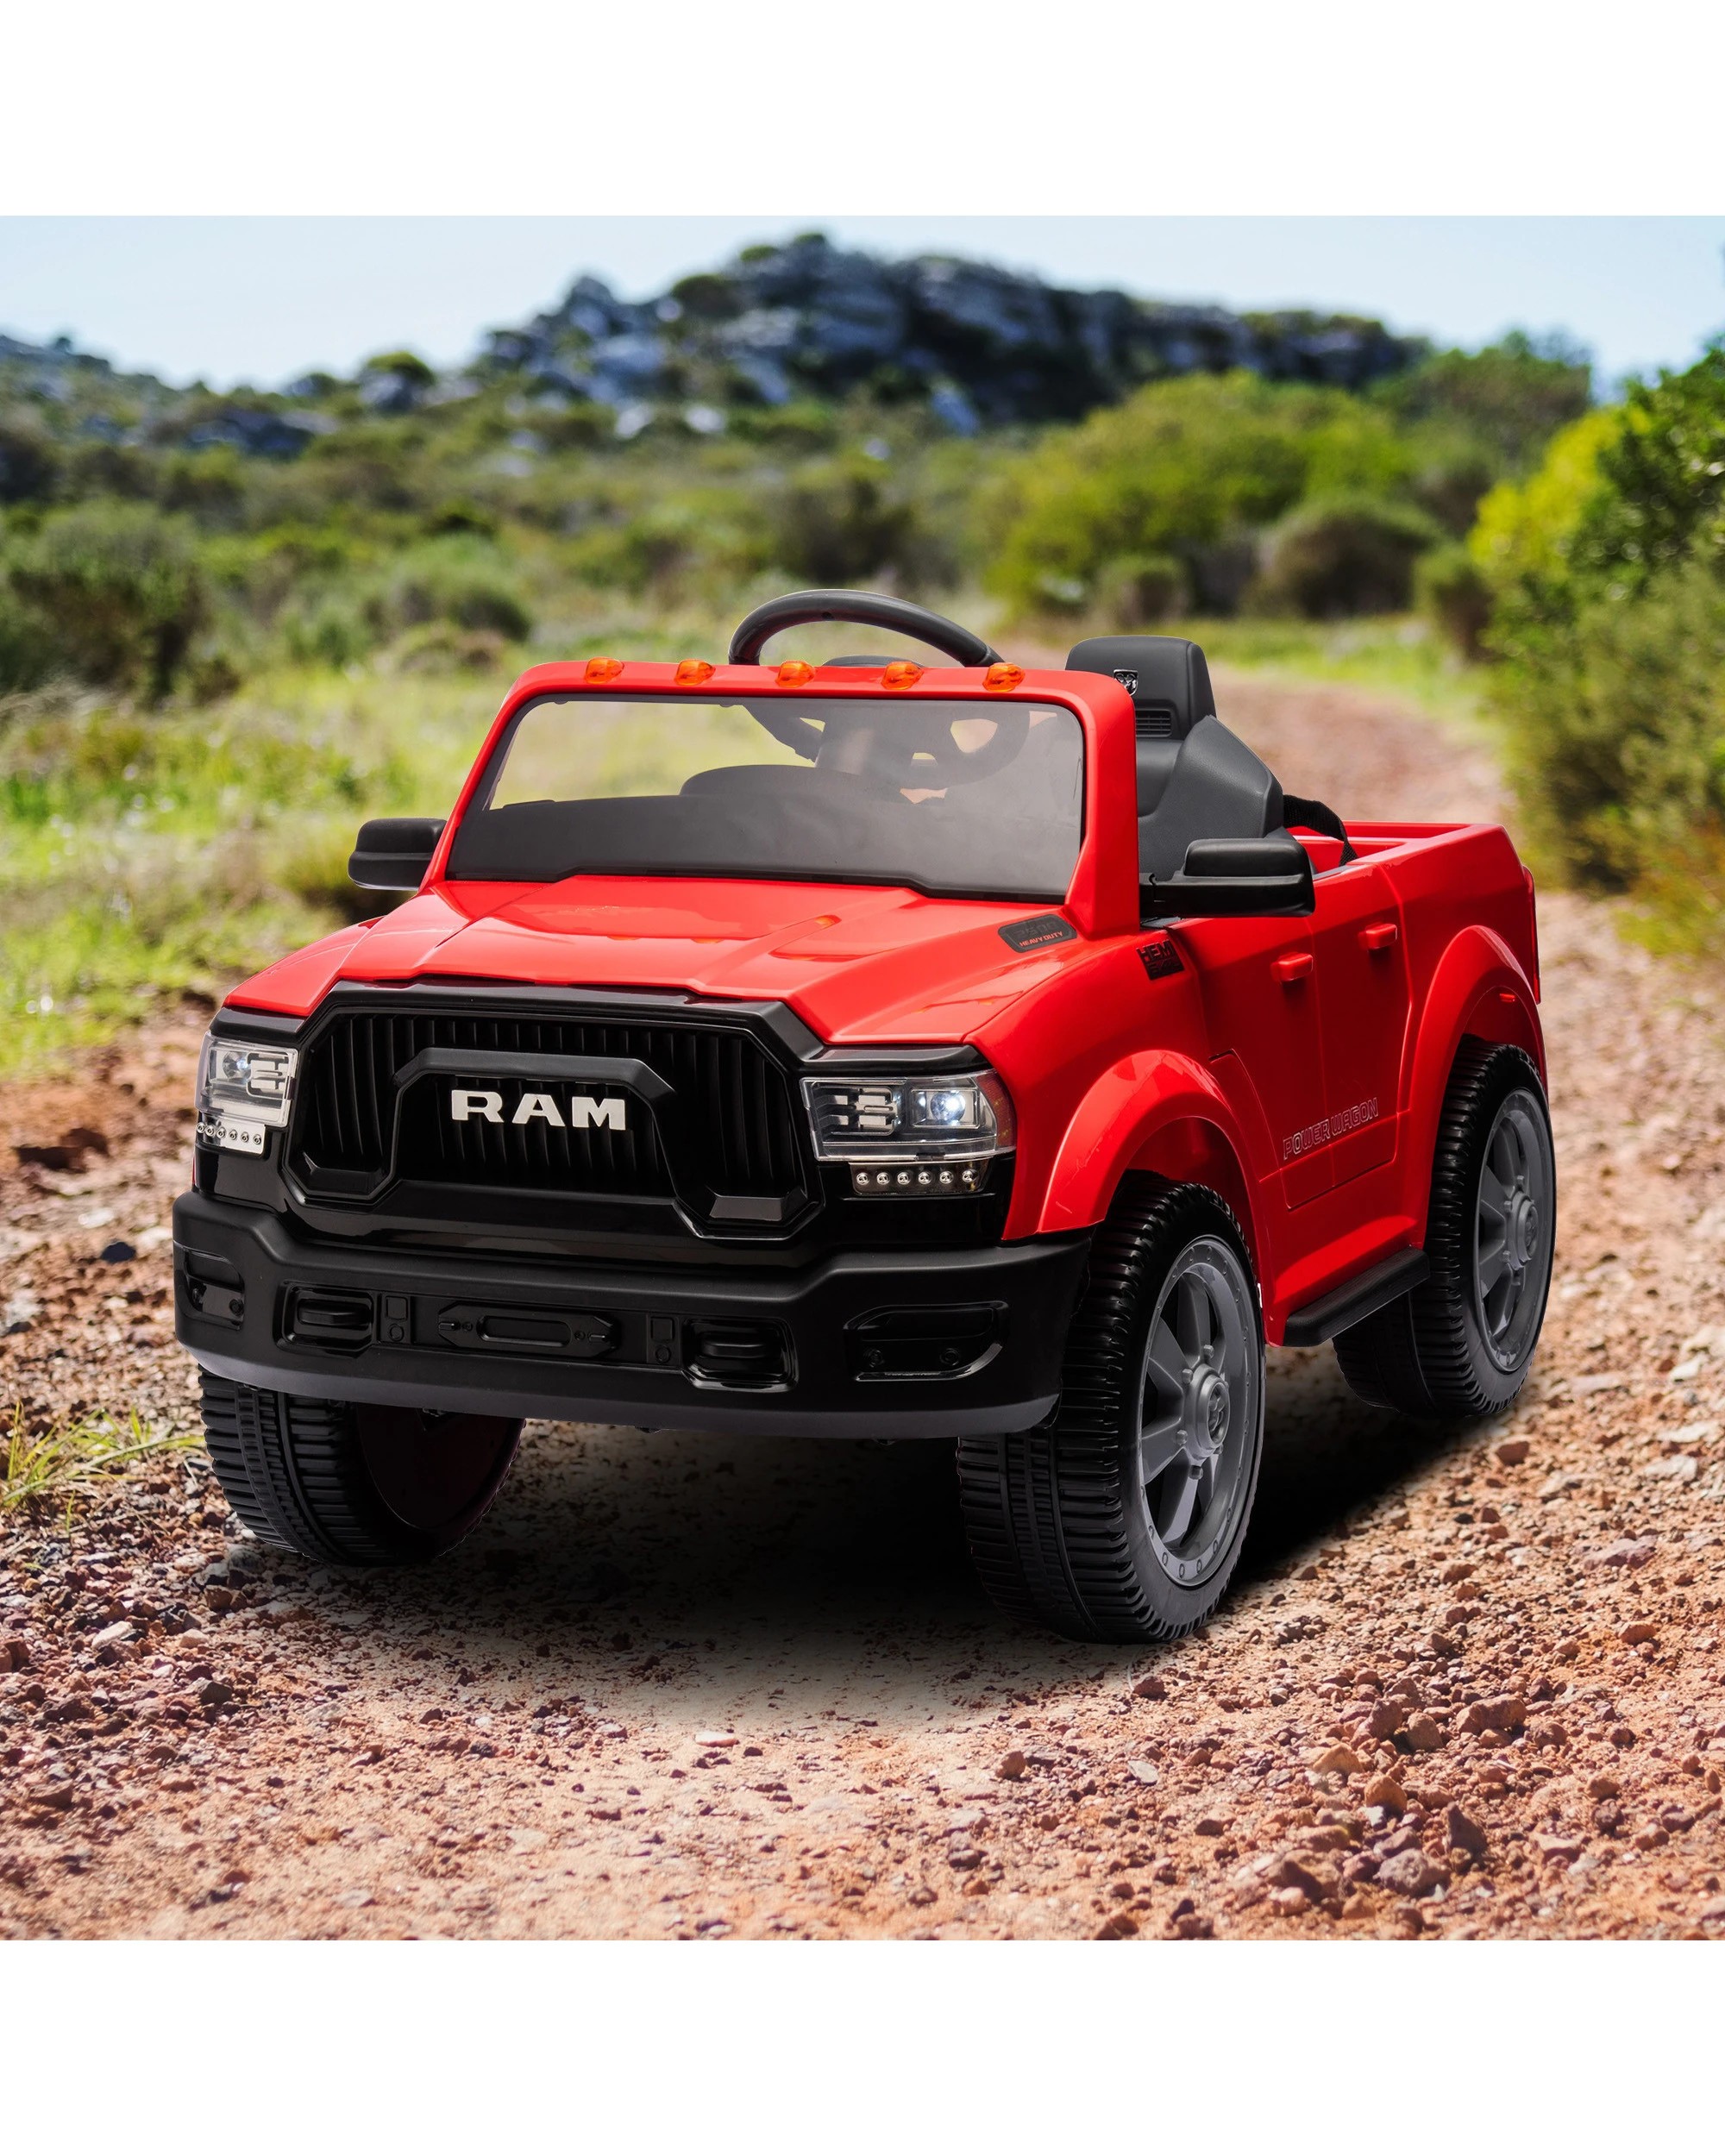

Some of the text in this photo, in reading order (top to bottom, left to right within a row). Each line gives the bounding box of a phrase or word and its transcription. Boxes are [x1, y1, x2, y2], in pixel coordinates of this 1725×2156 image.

[1019, 931, 1063, 947] HEAVY DUTY
[451, 1089, 626, 1131] RAM
[1283, 1097, 1379, 1161] POWER WAGON
